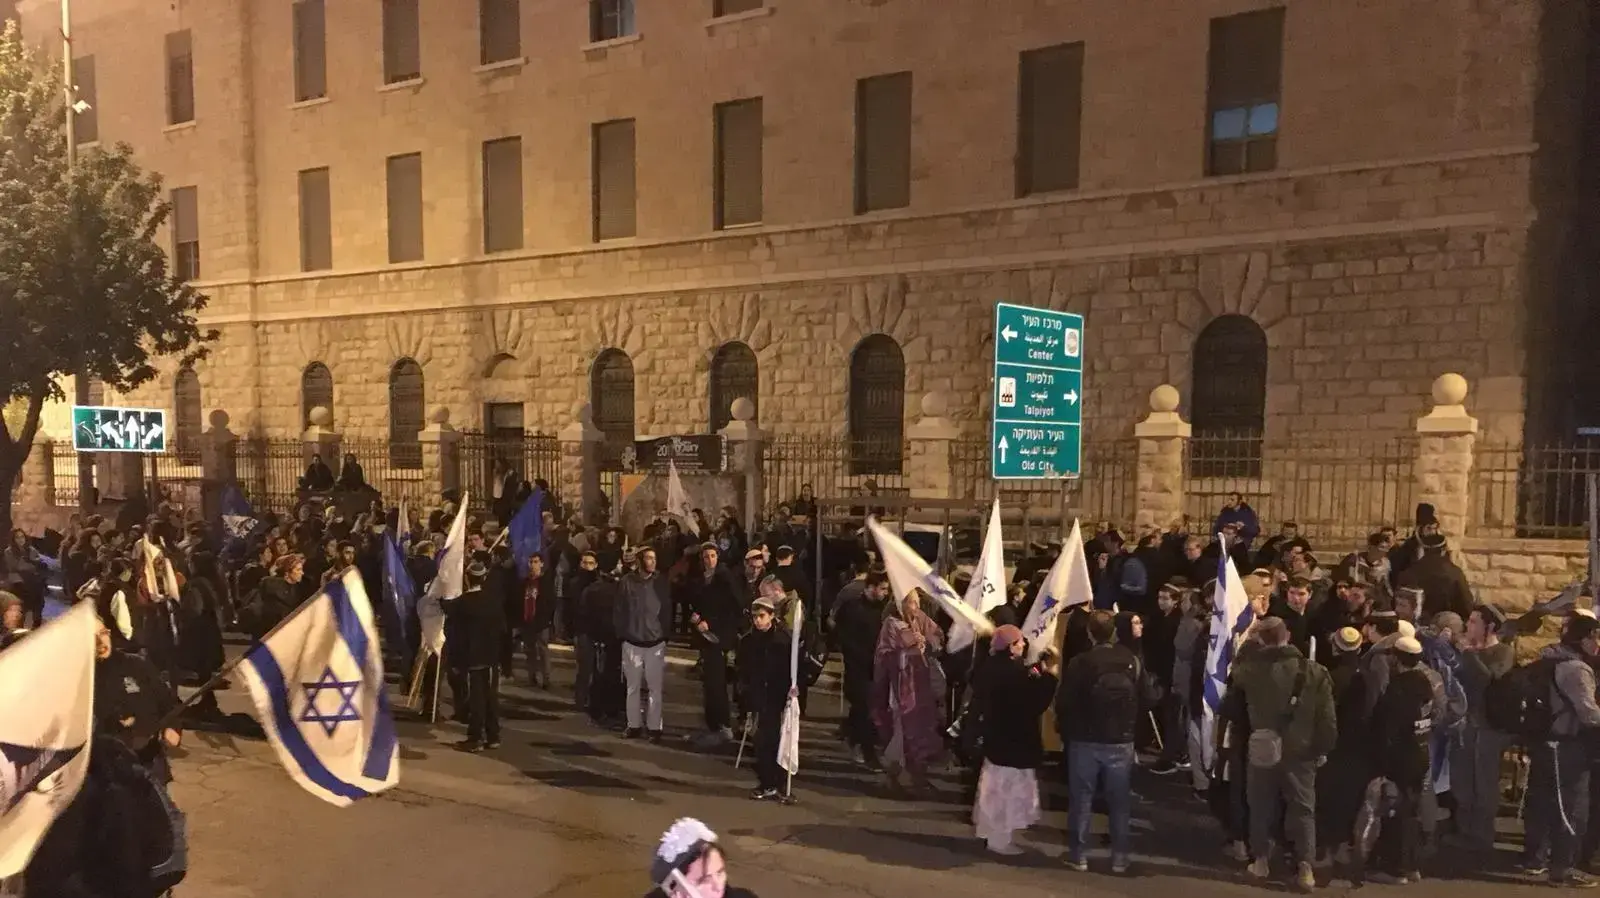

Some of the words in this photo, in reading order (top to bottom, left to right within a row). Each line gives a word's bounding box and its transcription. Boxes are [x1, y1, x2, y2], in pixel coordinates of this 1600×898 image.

[1022, 314, 1040, 328] העיר
[1043, 318, 1062, 331] מרכז
[1028, 348, 1054, 361] Center
[1025, 372, 1054, 385] תלפיות
[1024, 404, 1054, 418] Talpiyot
[1012, 428, 1044, 442] העתיקה
[1047, 430, 1065, 442] העיר
[1021, 460, 1036, 471] Old
[1038, 460, 1055, 471] City
